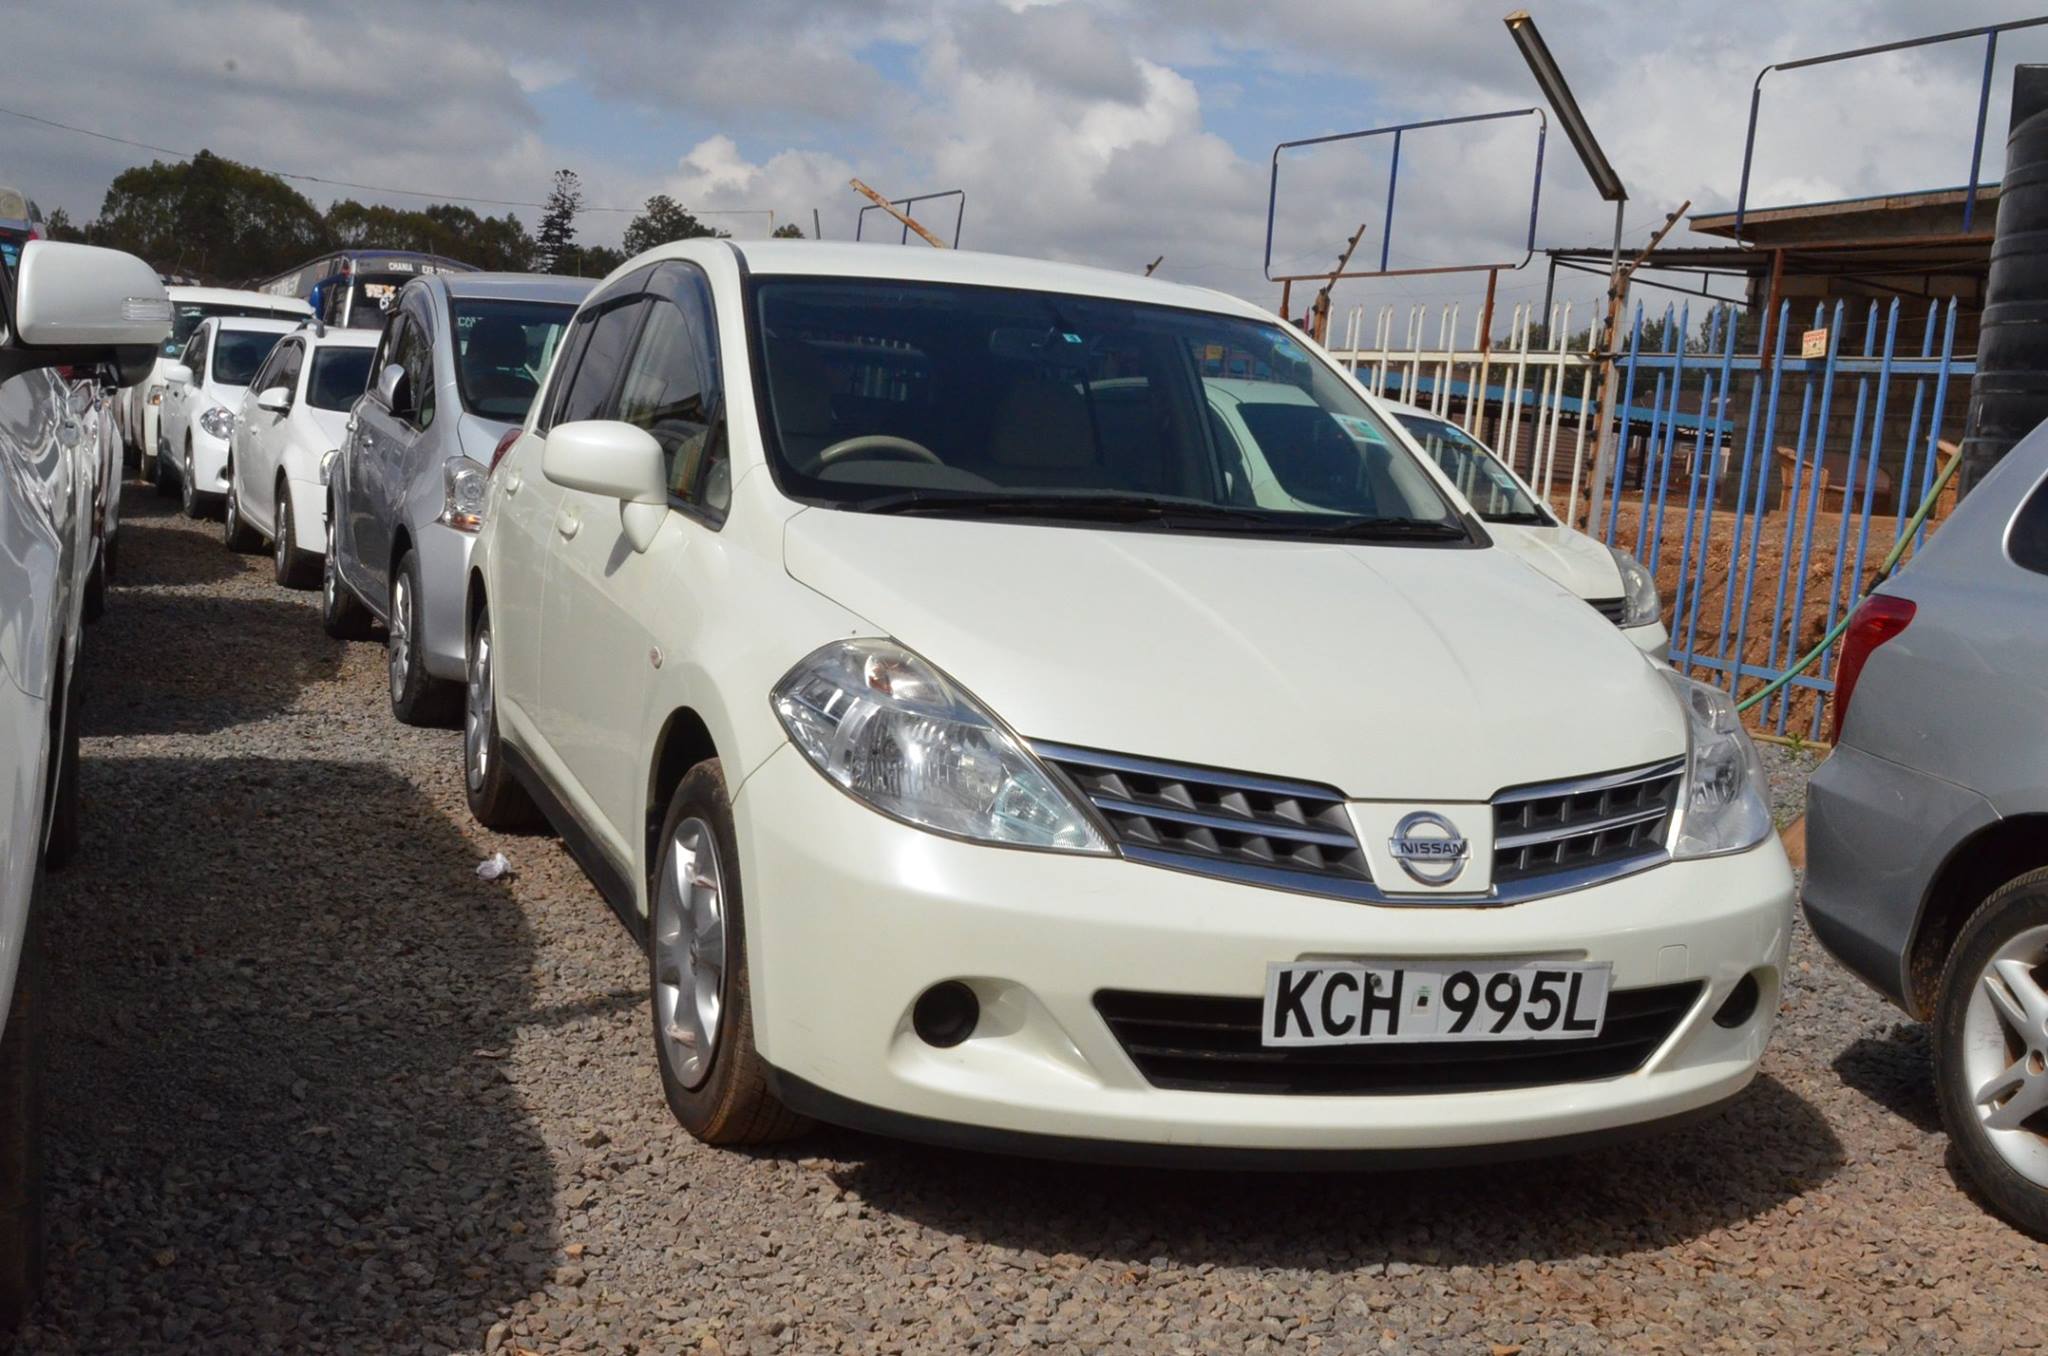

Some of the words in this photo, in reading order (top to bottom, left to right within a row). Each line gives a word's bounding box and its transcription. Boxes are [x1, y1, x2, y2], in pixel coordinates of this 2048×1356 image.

[388, 262, 413, 273] CHANIA
[1400, 842, 1466, 856] NISSAN
[1273, 969, 1404, 1039] KCH
[1442, 970, 1598, 1034] 995L
